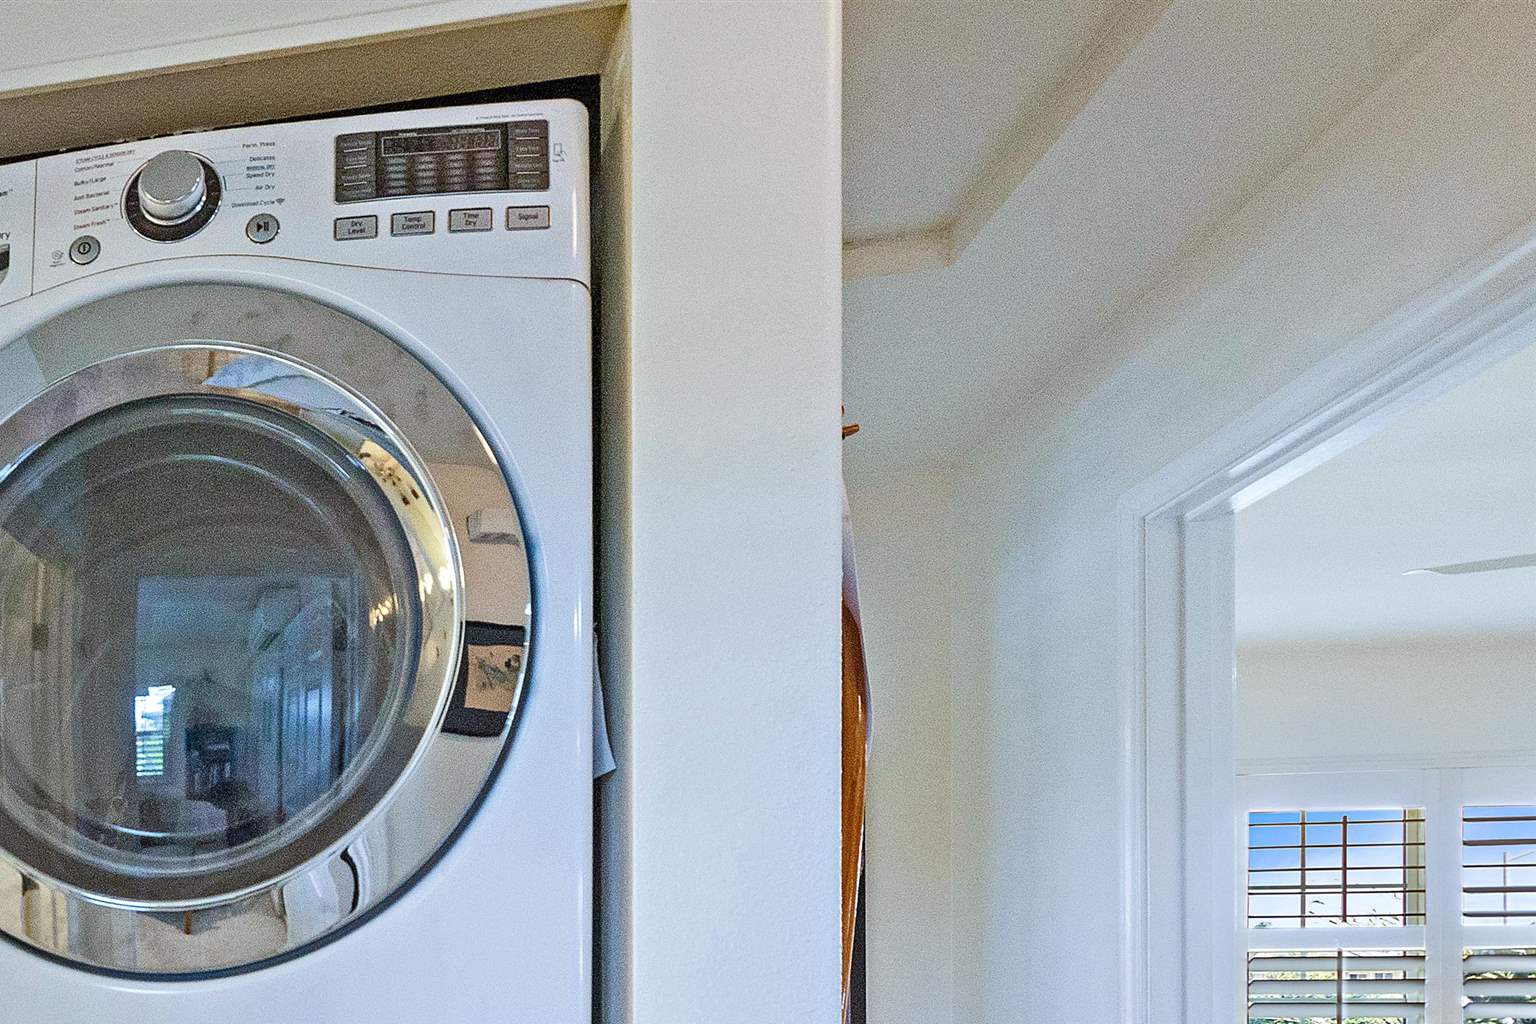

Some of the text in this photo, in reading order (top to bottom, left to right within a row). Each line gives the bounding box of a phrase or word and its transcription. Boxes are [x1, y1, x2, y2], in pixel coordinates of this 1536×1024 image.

[518, 212, 538, 221] Signal
[402, 222, 425, 230] Control
[348, 227, 365, 235] Level
